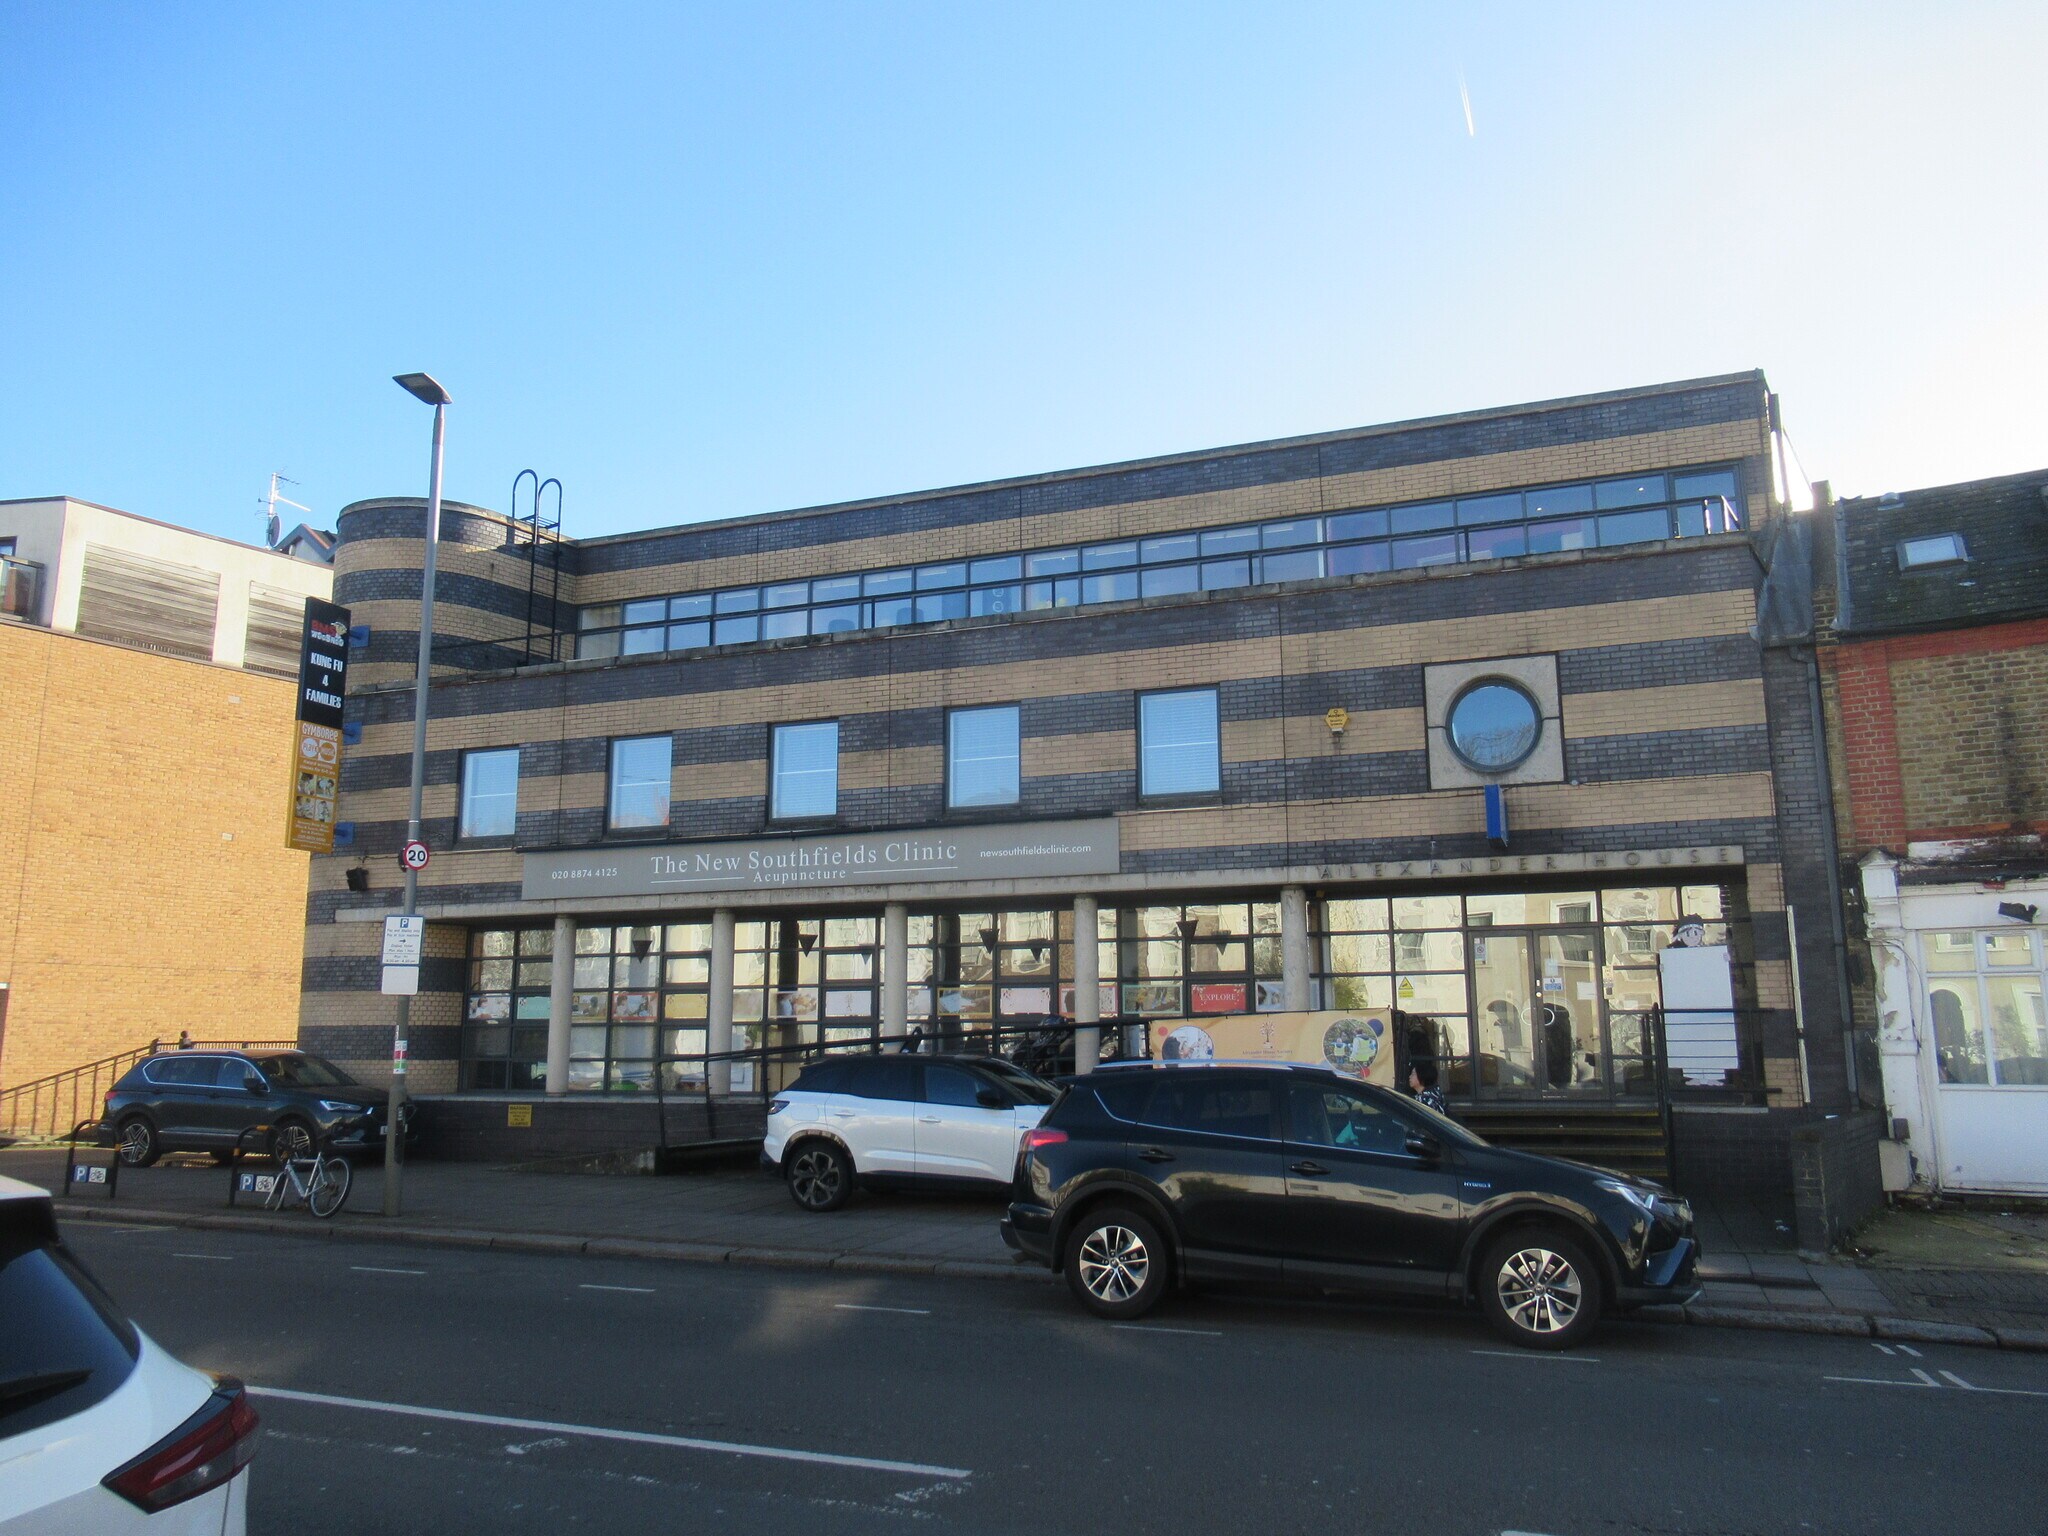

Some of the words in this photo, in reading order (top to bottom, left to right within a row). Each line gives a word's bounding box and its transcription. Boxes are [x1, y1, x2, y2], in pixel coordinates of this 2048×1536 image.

[311, 652, 332, 669] KUNG
[333, 659, 343, 673] FU
[322, 674, 329, 687] 4
[306, 688, 342, 709] FAMILIES
[408, 850, 426, 862] 20
[650, 855, 688, 875] The
[695, 853, 741, 872] New
[748, 845, 877, 870] Southfields
[885, 840, 957, 862] Clinic
[980, 844, 1092, 858] newsouthfieldsclinic.com
[1321, 856, 1557, 880] ALEXANDER
[1594, 848, 1728, 867] HOUSE
[552, 870, 569, 880] 020
[571, 868, 592, 878] 8874
[595, 867, 618, 877] 4125
[753, 868, 846, 884] Acupuncture
[1200, 993, 1236, 1001] EXPLORE
